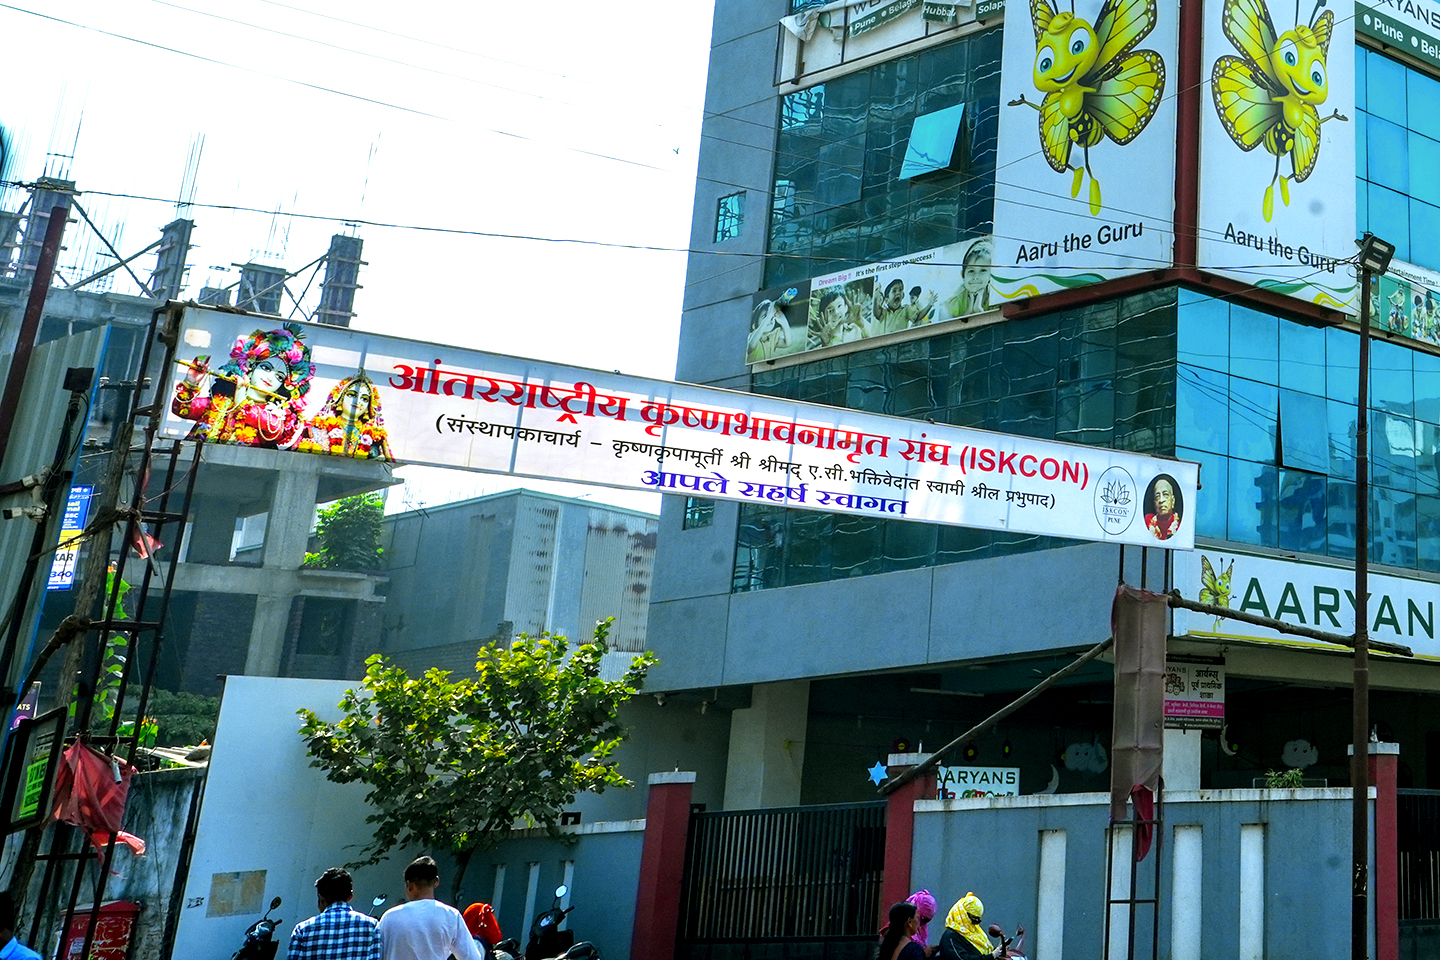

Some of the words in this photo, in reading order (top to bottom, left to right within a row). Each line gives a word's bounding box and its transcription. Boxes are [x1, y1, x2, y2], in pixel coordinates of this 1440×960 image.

[854, 15, 876, 31] Pune
[1374, 17, 1404, 42] Pune
[1015, 241, 1058, 265] Aaru
[1062, 233, 1092, 255] the
[1096, 221, 1144, 245] Guru
[1224, 222, 1263, 252] Aaru
[1267, 236, 1293, 259] the
[1297, 245, 1337, 275] Guru
[389, 358, 630, 425] आंतरराष्ट्रीय
[640, 400, 891, 464] कृष्णभावनामृत
[898, 433, 951, 466] संघ
[960, 445, 1089, 490] (ISKCON)
[641, 470, 730, 494] आपले
[738, 483, 810, 503] सहर्ष
[816, 490, 909, 515] स्वागत
[731, 451, 751, 469] श्री
[758, 455, 802, 480] श्रीमद्
[927, 479, 965, 497] स्वामी
[971, 483, 1000, 501] श्रील
[1006, 489, 1056, 510] प्रभुपाद)
[1102, 506, 1127, 516] ISKCON
[1107, 517, 1121, 525] PUNE
